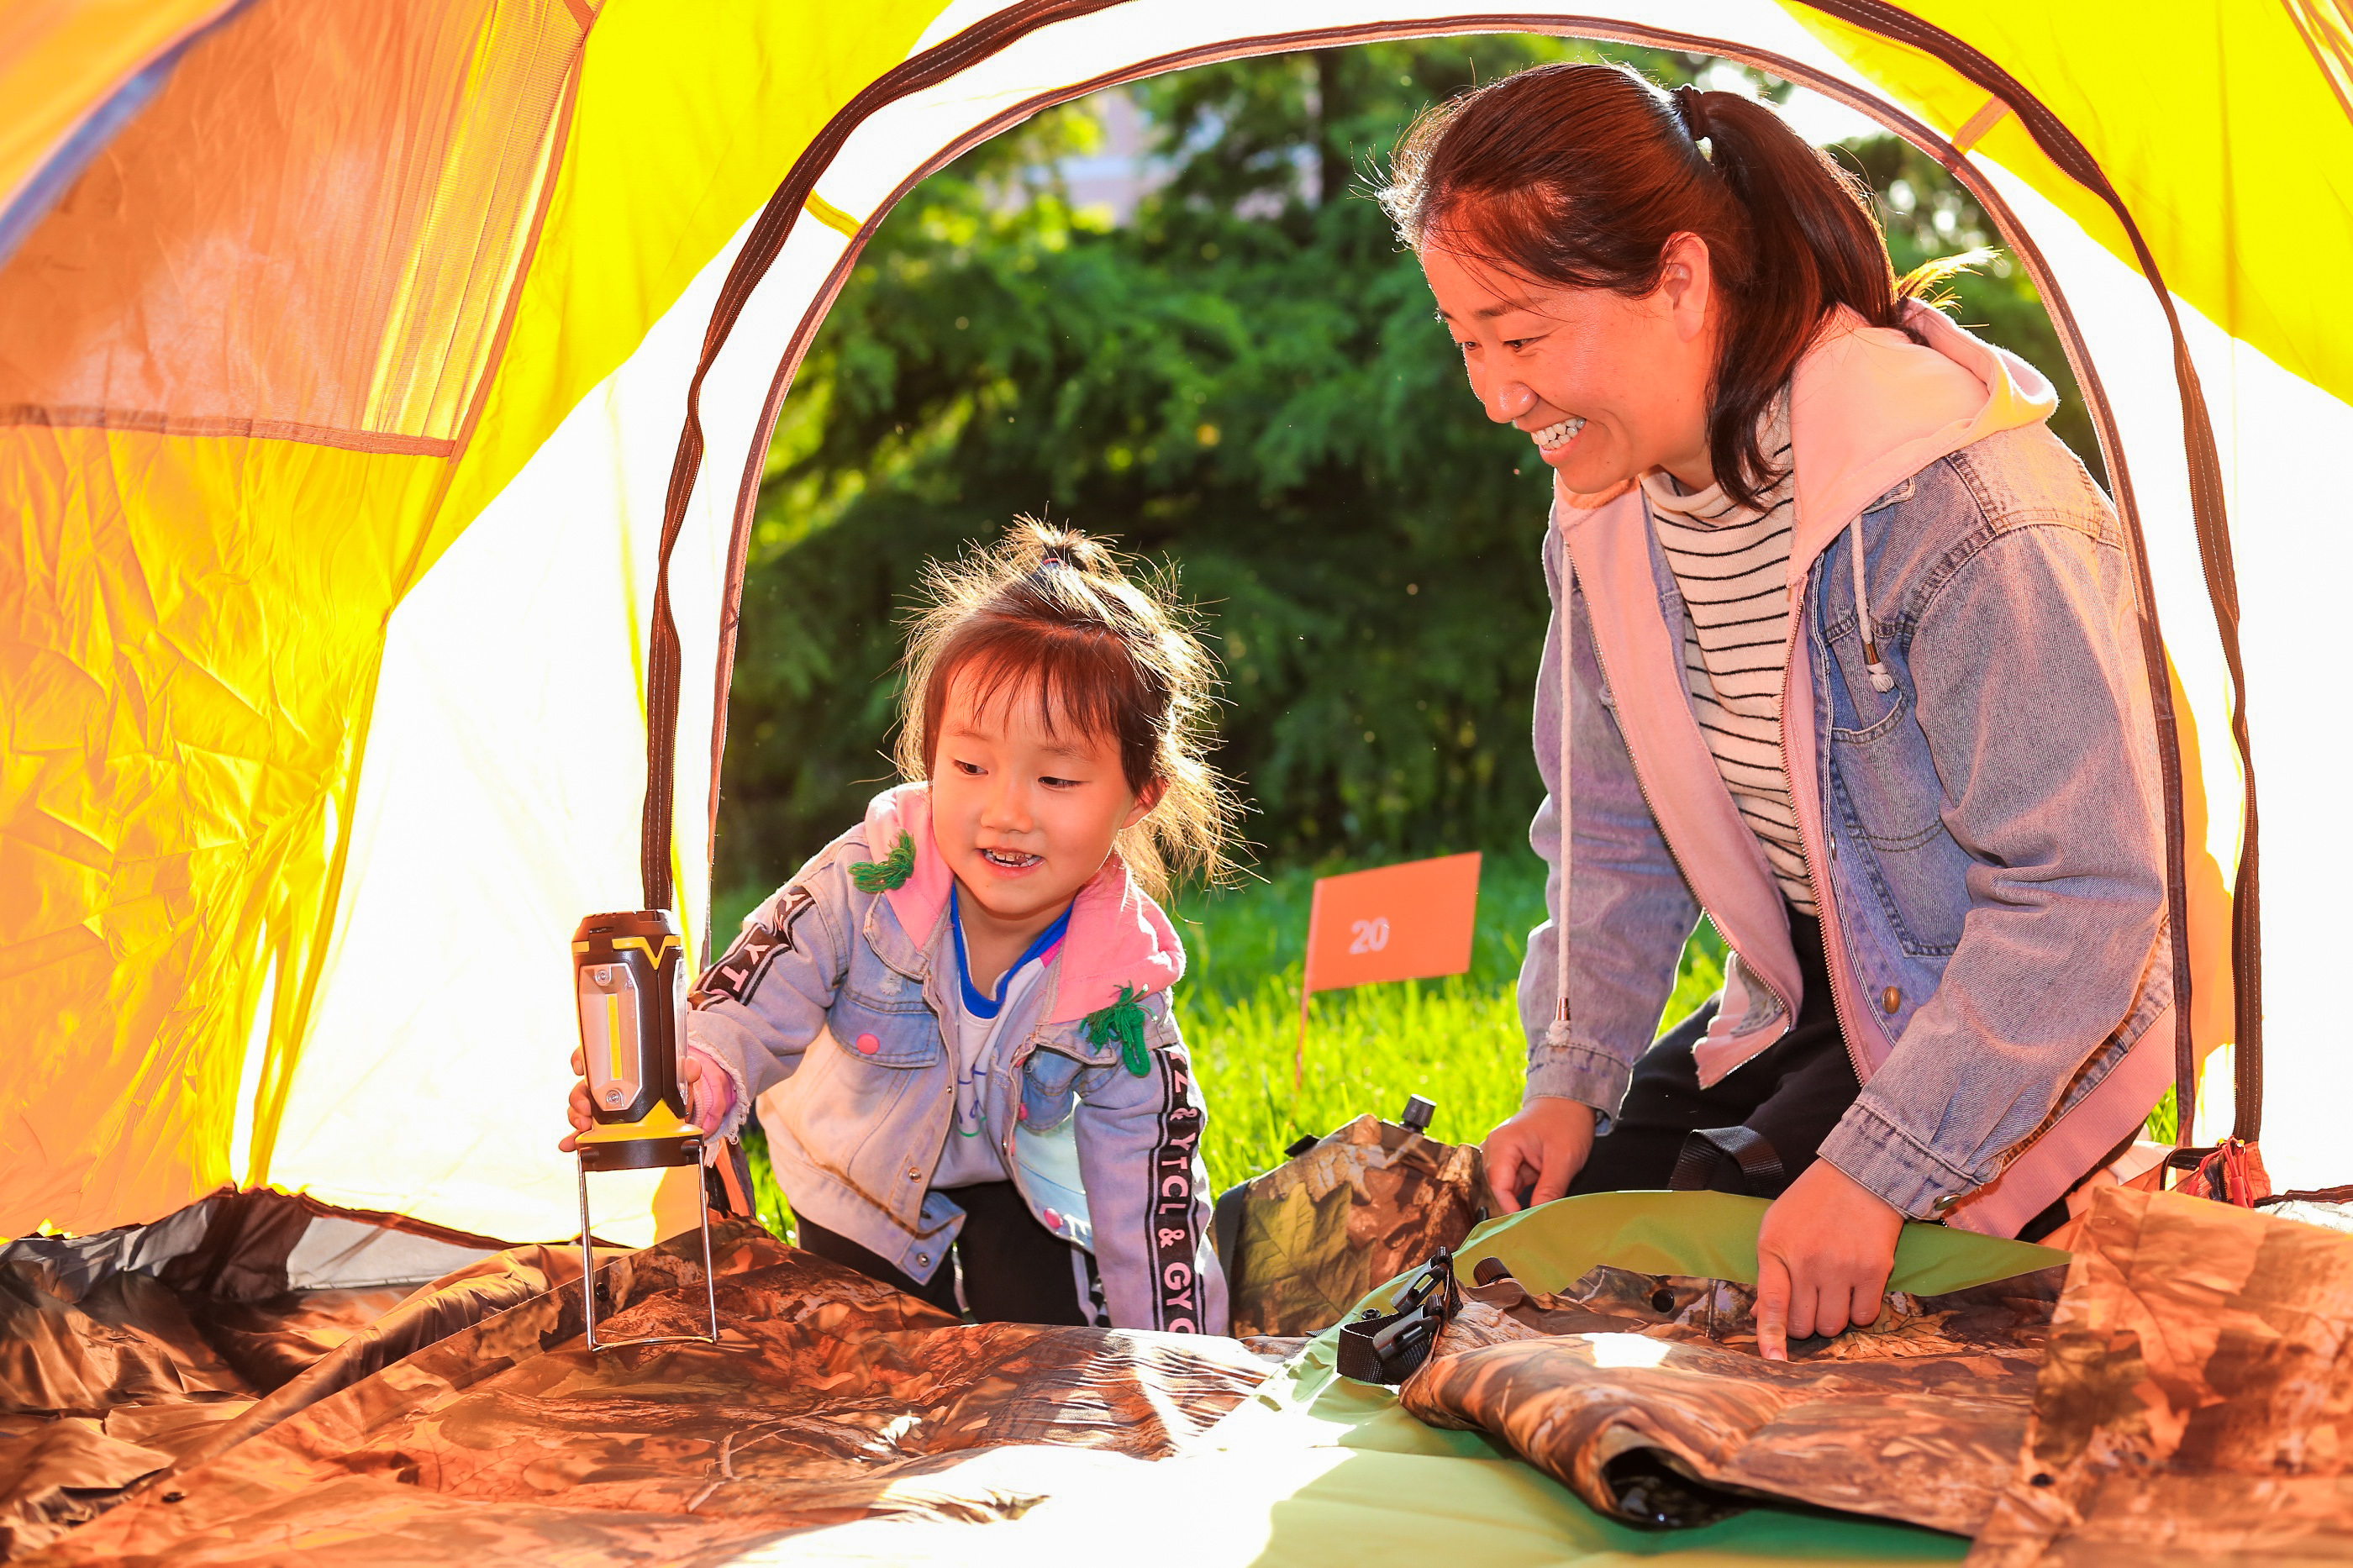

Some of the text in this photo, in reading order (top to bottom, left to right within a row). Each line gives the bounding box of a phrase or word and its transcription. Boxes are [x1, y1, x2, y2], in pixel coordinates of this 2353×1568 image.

[1349, 916, 1390, 955] 20
[1169, 1108, 1198, 1122] &
[1158, 1132, 1197, 1215] YTCL
[1157, 1228, 1186, 1249] &
